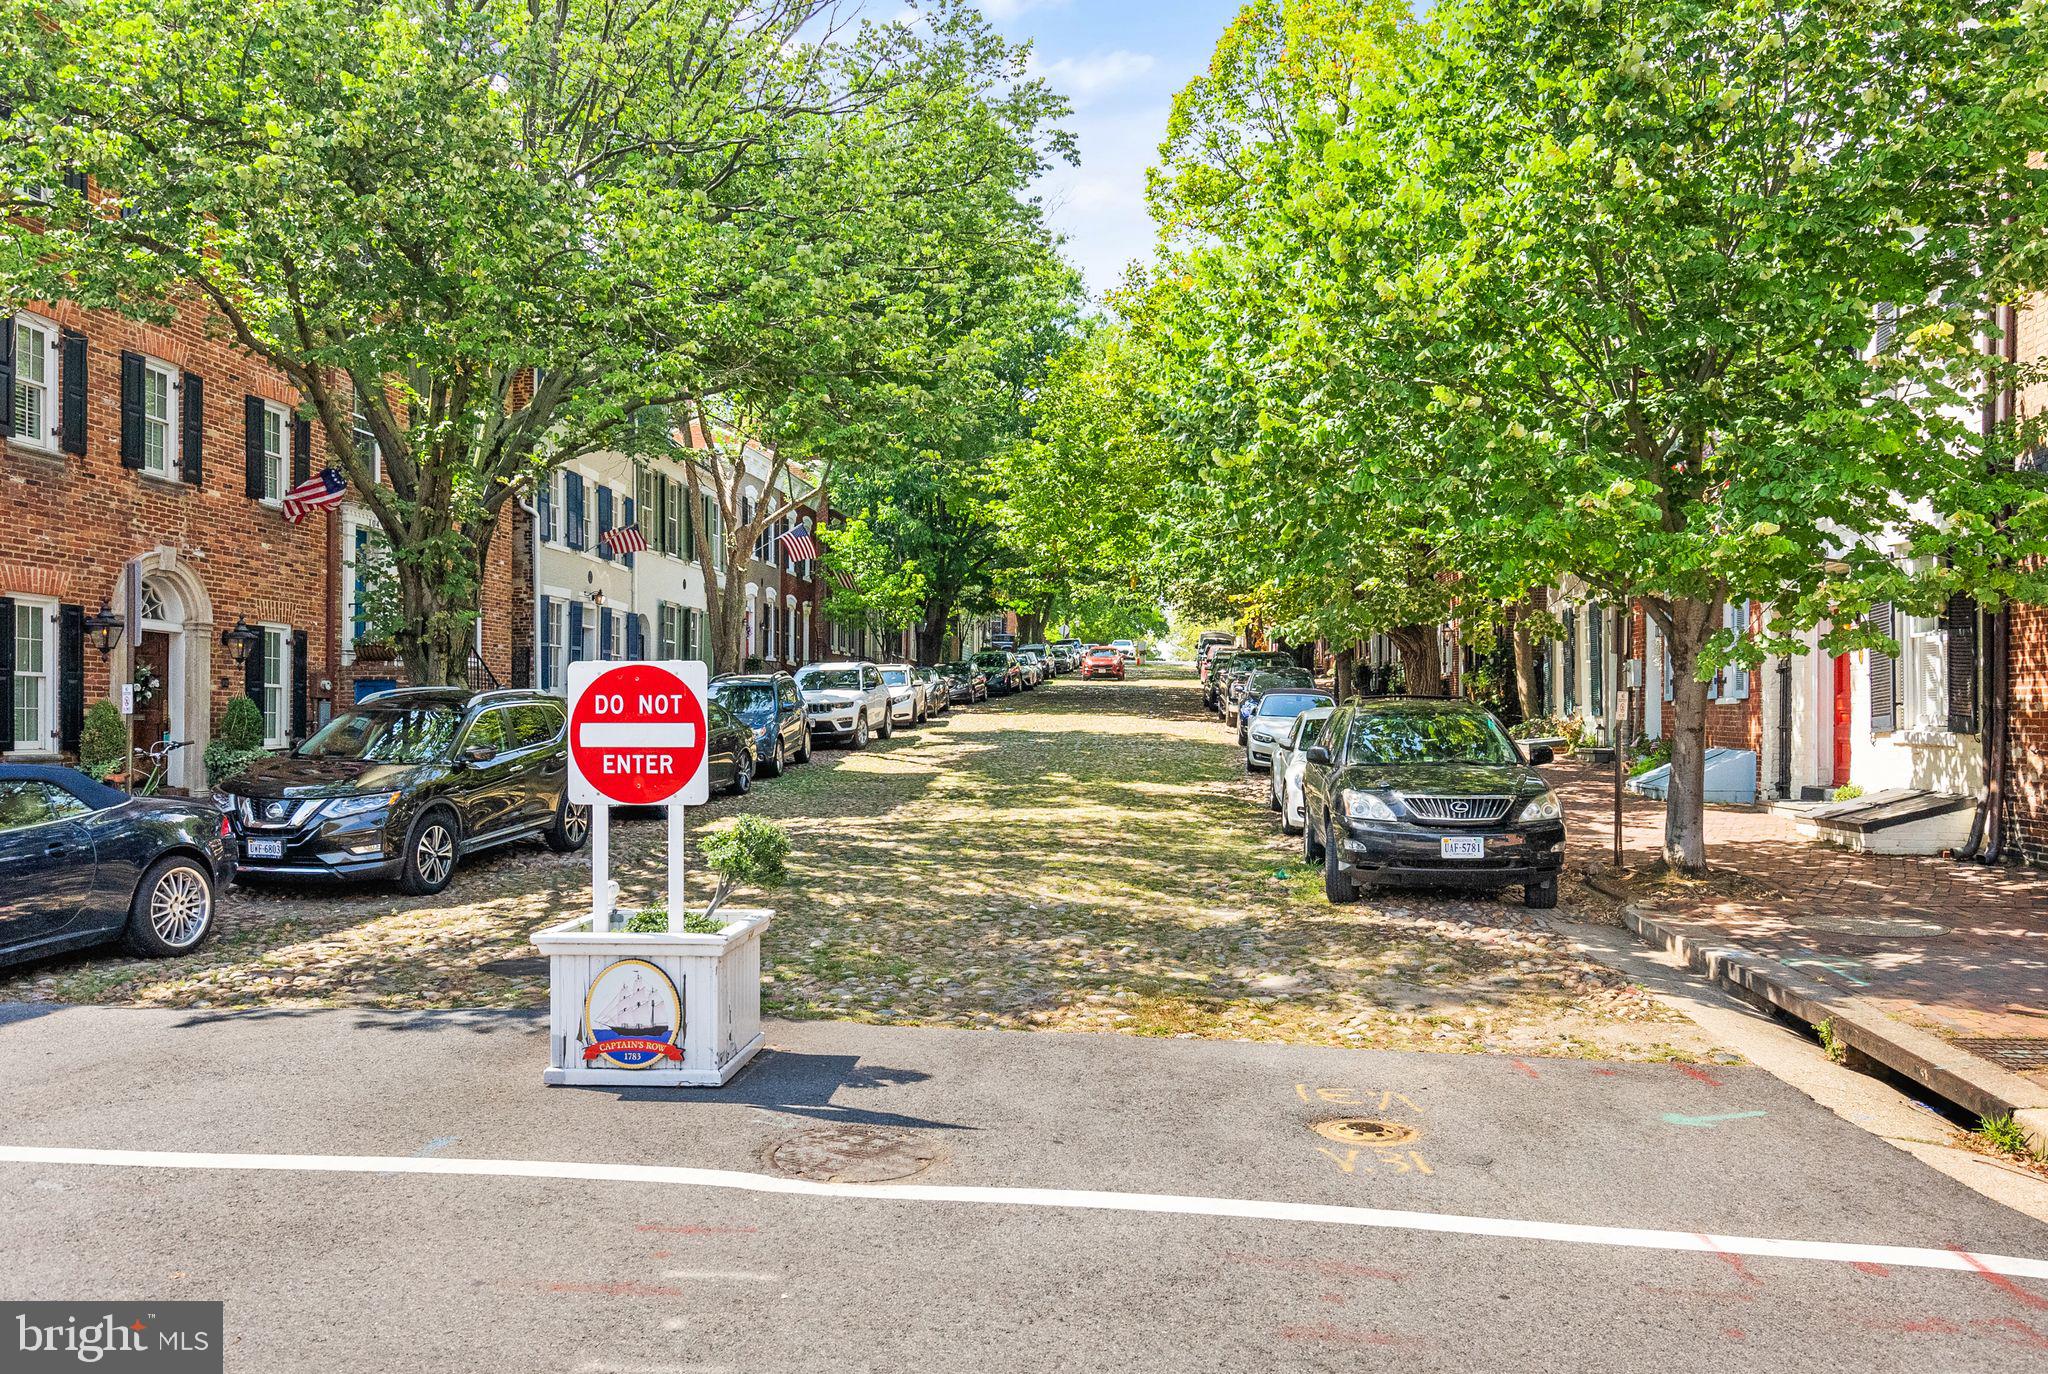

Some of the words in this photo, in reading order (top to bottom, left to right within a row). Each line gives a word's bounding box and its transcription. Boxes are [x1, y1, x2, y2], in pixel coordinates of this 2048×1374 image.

[594, 694, 624, 715] DO
[638, 694, 683, 715] NOT
[602, 754, 674, 775] ENTER
[600, 1040, 644, 1052] CAPTAIN'S
[646, 1042, 667, 1052] ROW
[624, 1052, 641, 1061] 1783
